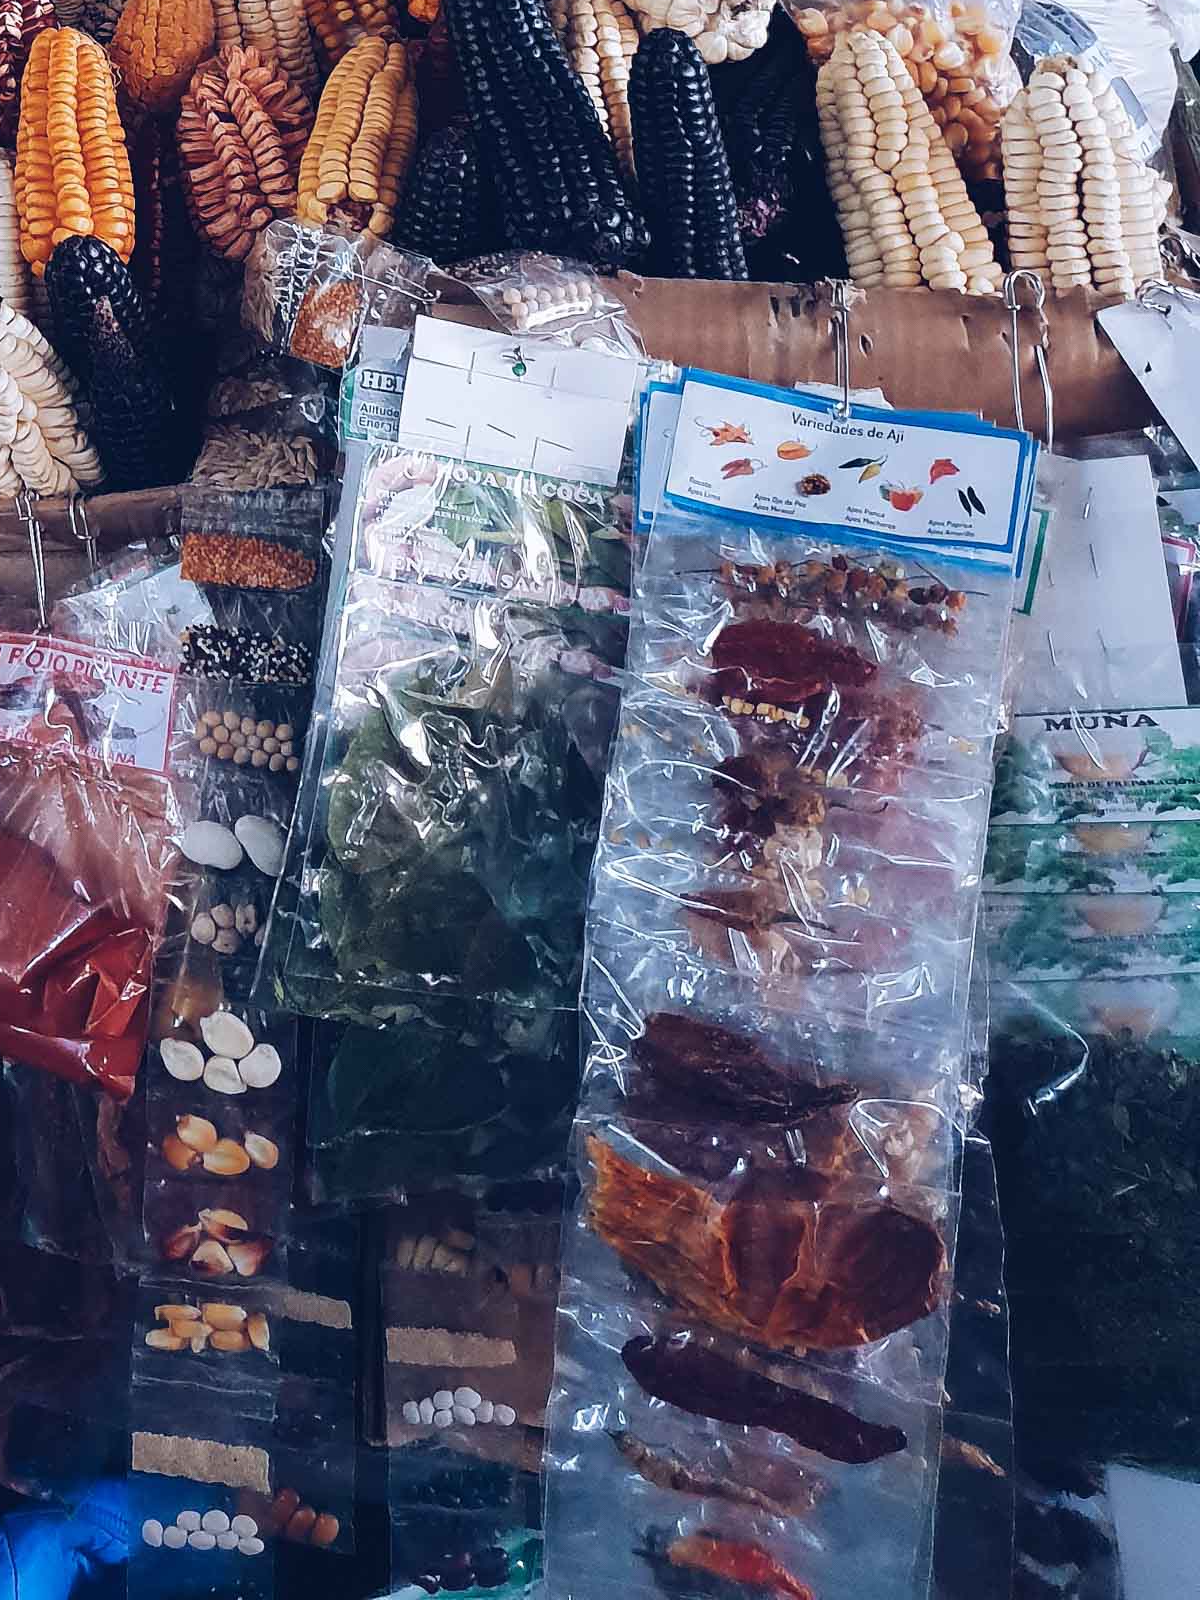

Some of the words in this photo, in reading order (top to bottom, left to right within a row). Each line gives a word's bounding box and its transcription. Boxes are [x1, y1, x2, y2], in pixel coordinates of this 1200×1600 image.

[792, 411, 864, 437] Variedades
[866, 426, 884, 440] de
[542, 482, 606, 511] COCA
[1043, 711, 1160, 733] MUÑA
[1087, 780, 1101, 789] DE
